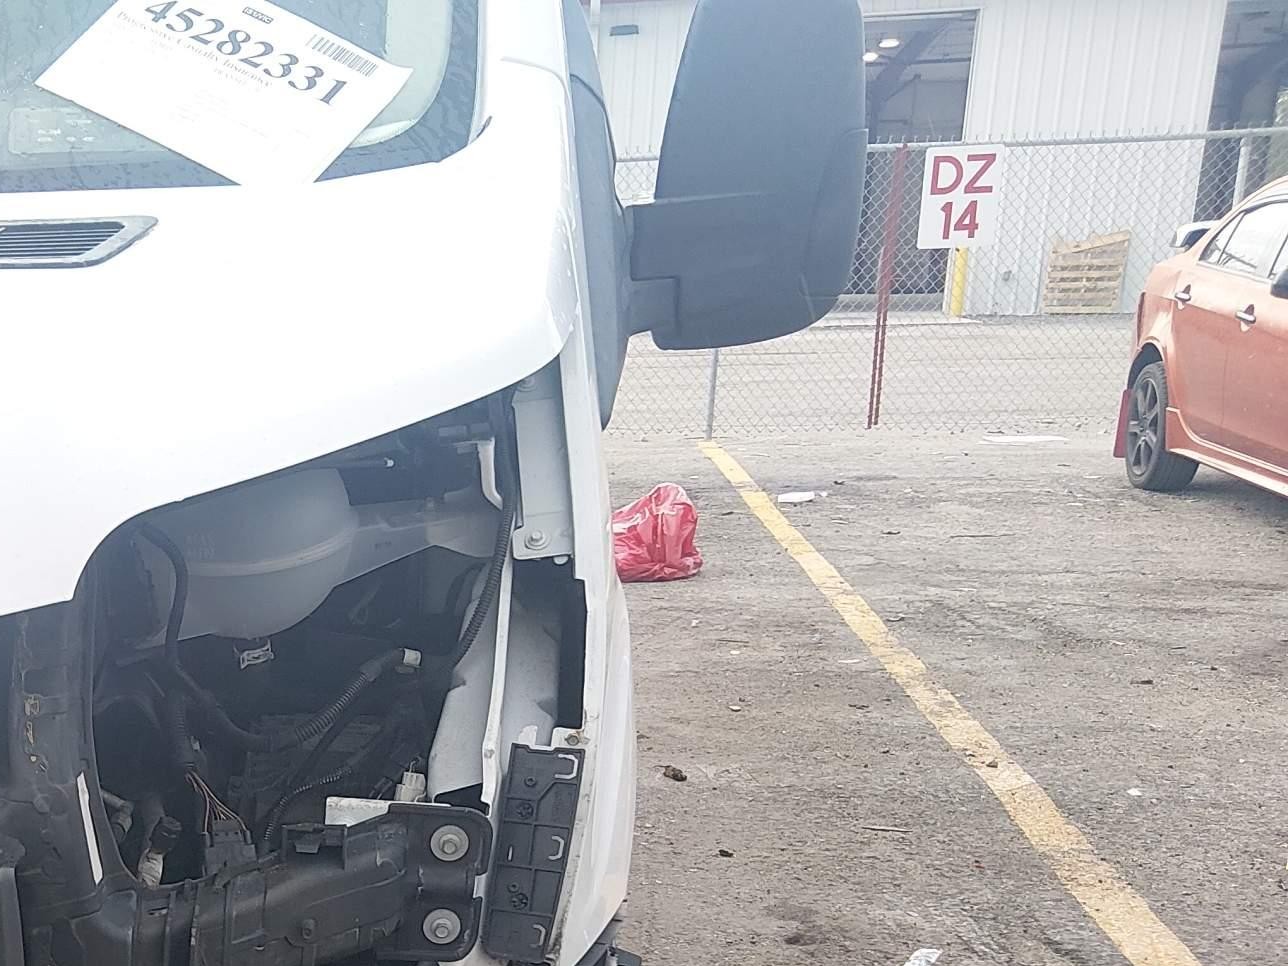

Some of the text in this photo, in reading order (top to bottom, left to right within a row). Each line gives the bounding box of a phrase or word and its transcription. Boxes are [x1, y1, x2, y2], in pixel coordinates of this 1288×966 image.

[144, 0, 347, 105] 45282331
[930, 153, 996, 195] DZ
[940, 200, 979, 240] 14
